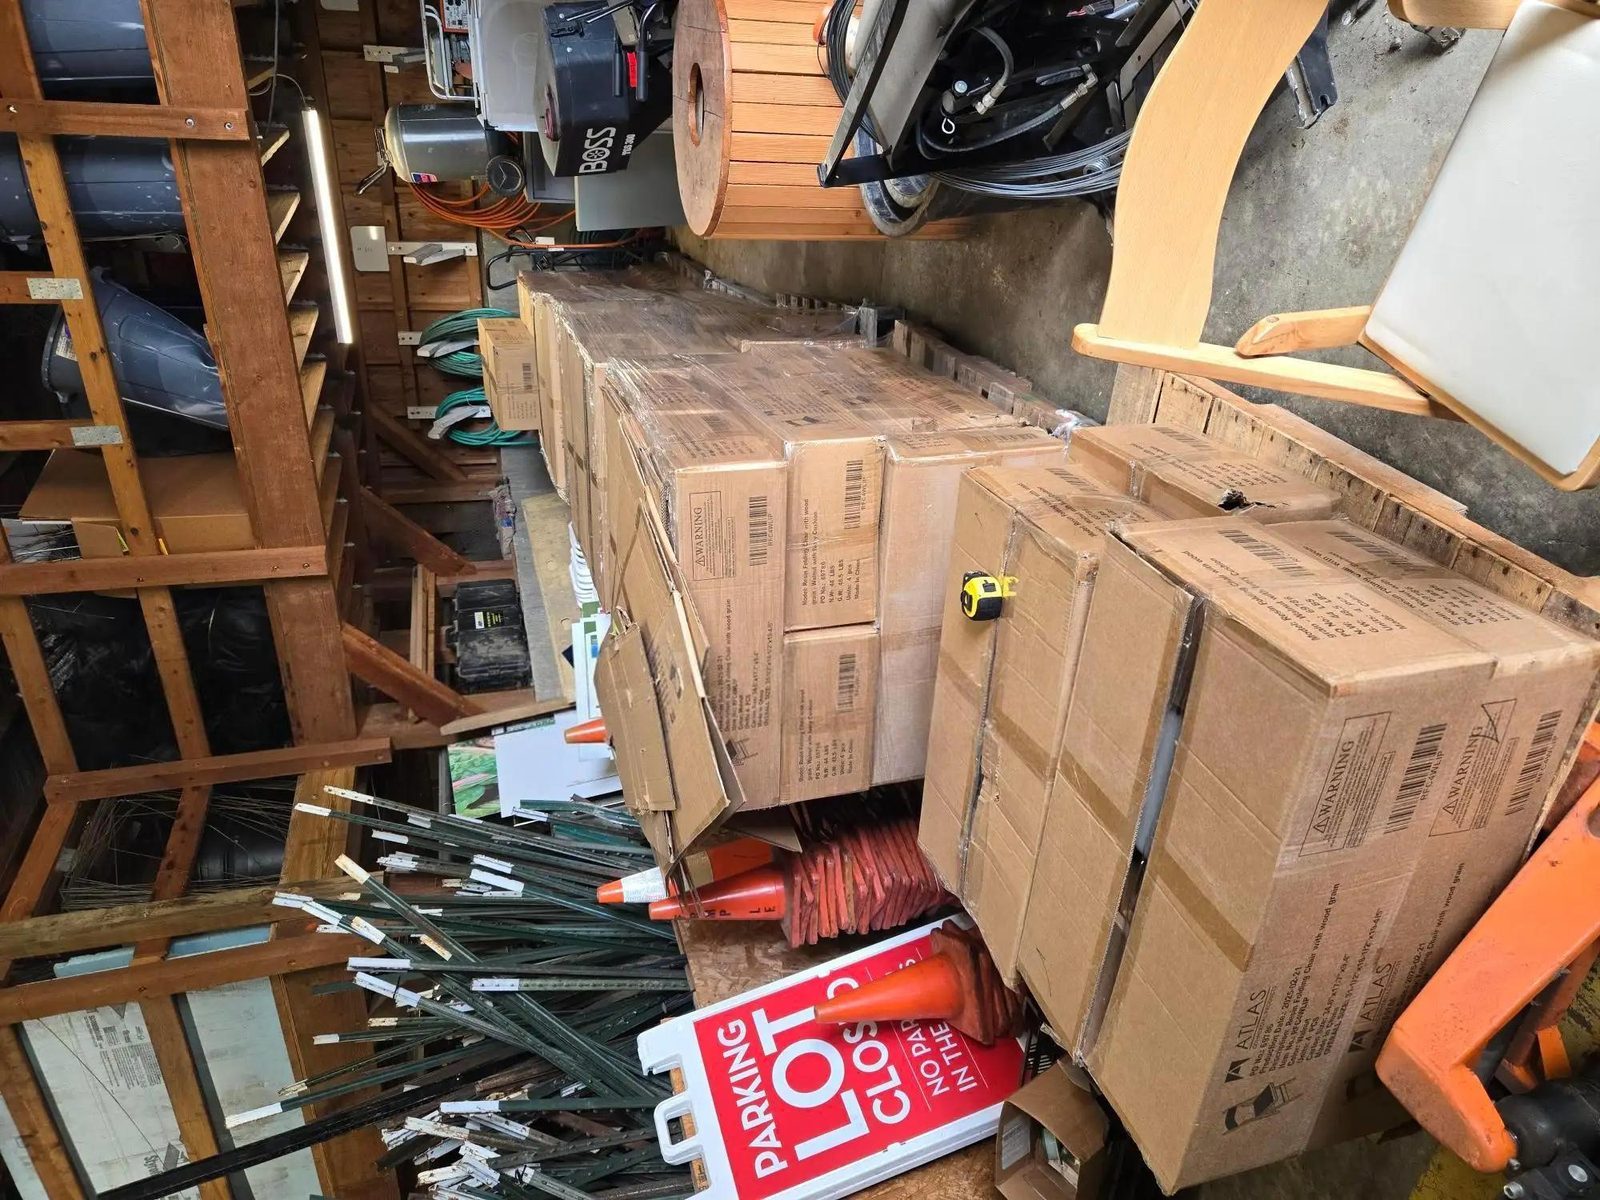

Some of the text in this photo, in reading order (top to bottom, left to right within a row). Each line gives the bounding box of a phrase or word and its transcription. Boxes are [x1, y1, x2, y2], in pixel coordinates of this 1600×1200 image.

[578, 126, 616, 172] BOSS
[624, 133, 635, 144] 300
[693, 507, 703, 555] WARNING
[1181, 550, 1319, 640] Model: Resin Folding Chair with wood
[1254, 589, 1276, 600] with
[1273, 601, 1305, 618] Walnut
[1304, 598, 1325, 608] LBS
[1310, 592, 1332, 602] LBS
[1307, 623, 1336, 638] grain
[1332, 627, 1351, 636] PO
[1317, 740, 1355, 817] WARNING
[1446, 726, 1484, 798] WARNING
[1442, 885, 1455, 908] wood
[1451, 861, 1464, 884] grain
[1270, 882, 1341, 1070] Description: Resin Folding Chair with wood grain
[1360, 963, 1392, 1024] ATLAS
[1236, 989, 1268, 1050] ATLAS
[1259, 1034, 1278, 1073] Production
[1281, 966, 1301, 1009] 2025-02-21
[1288, 1017, 1310, 1065] Color: Walnut
[1308, 1016, 1319, 1032] PCS
[827, 977, 911, 1125] CLOSD
[930, 1022, 977, 1092] IN THE
[1249, 1064, 1259, 1076] PO
[718, 1019, 789, 1179] PARKING
[752, 1006, 869, 1161] LOT
[921, 1060, 950, 1097] NO
